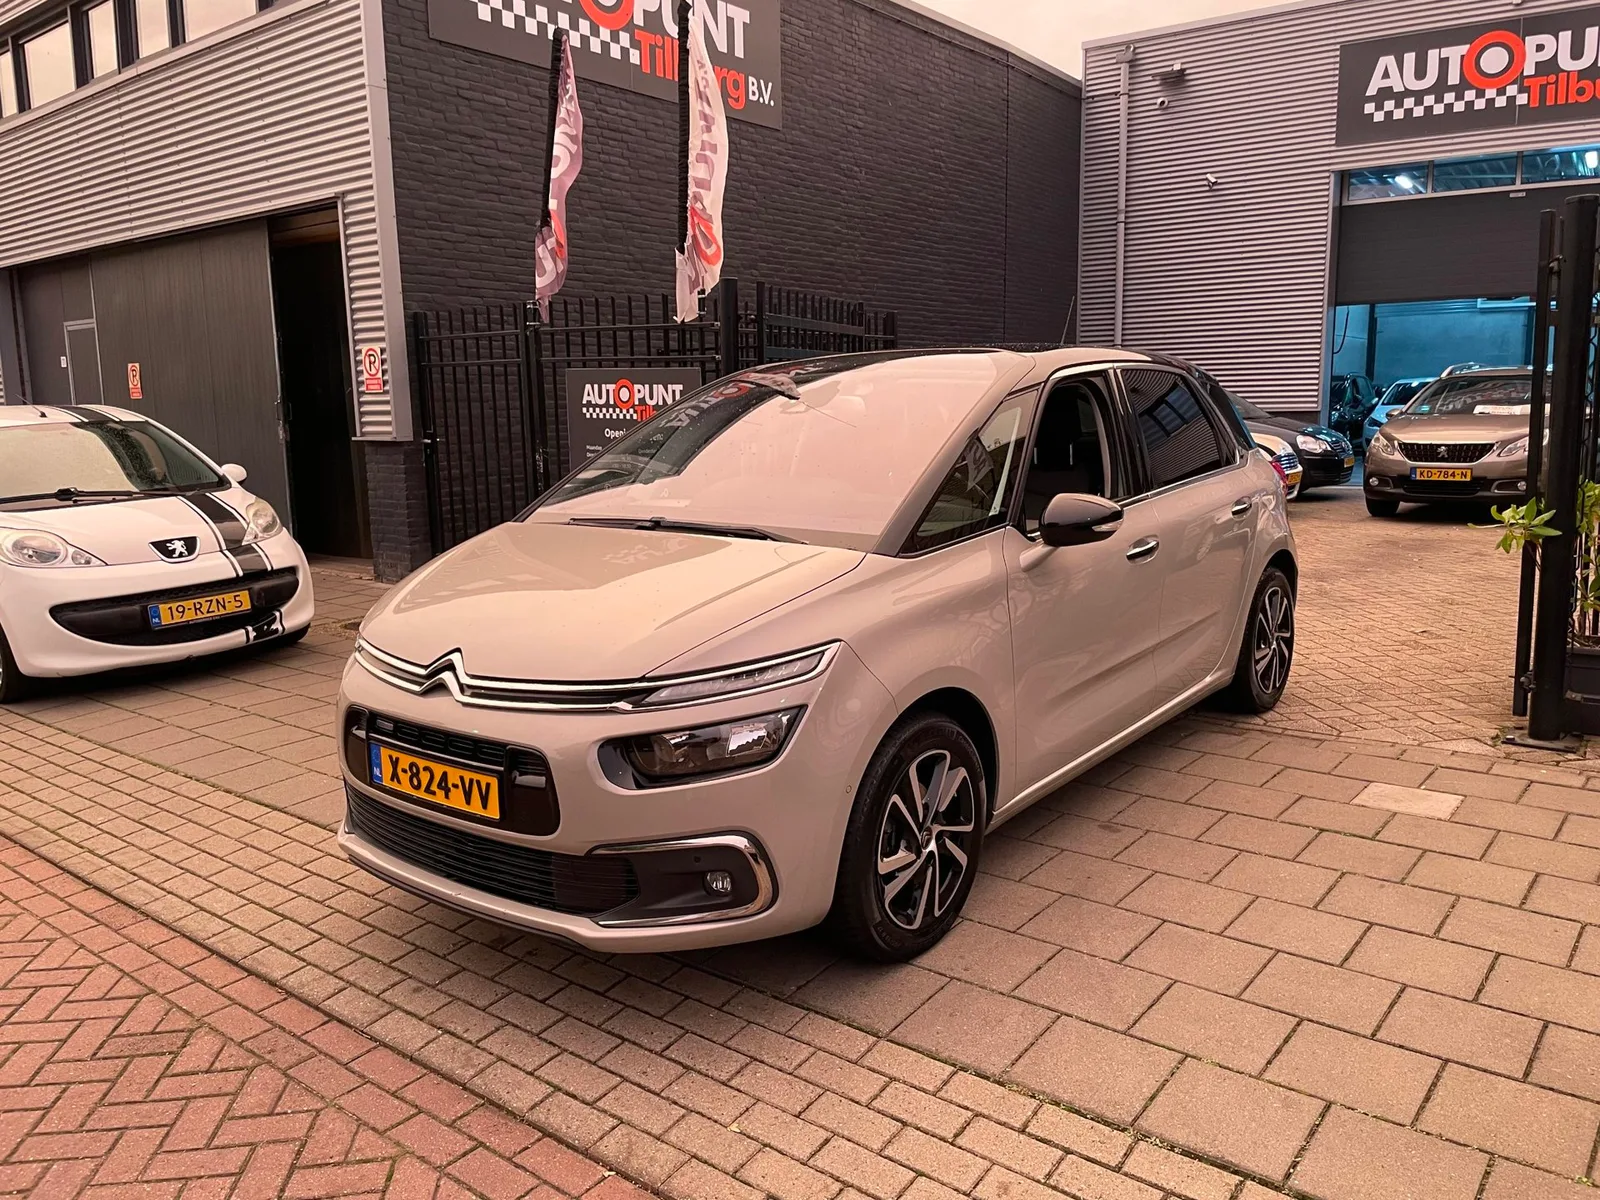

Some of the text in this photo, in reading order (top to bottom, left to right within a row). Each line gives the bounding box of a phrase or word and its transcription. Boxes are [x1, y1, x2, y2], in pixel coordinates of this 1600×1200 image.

[634, 28, 774, 110] Tilrg B.V.
[1365, 26, 1600, 96] AUTOPU
[582, 379, 683, 409] AUTOPUNT
[1419, 471, 1467, 479] KD-784-N
[168, 594, 243, 621] 19-RZN-5
[373, 754, 491, 810] NL X-824-VV
